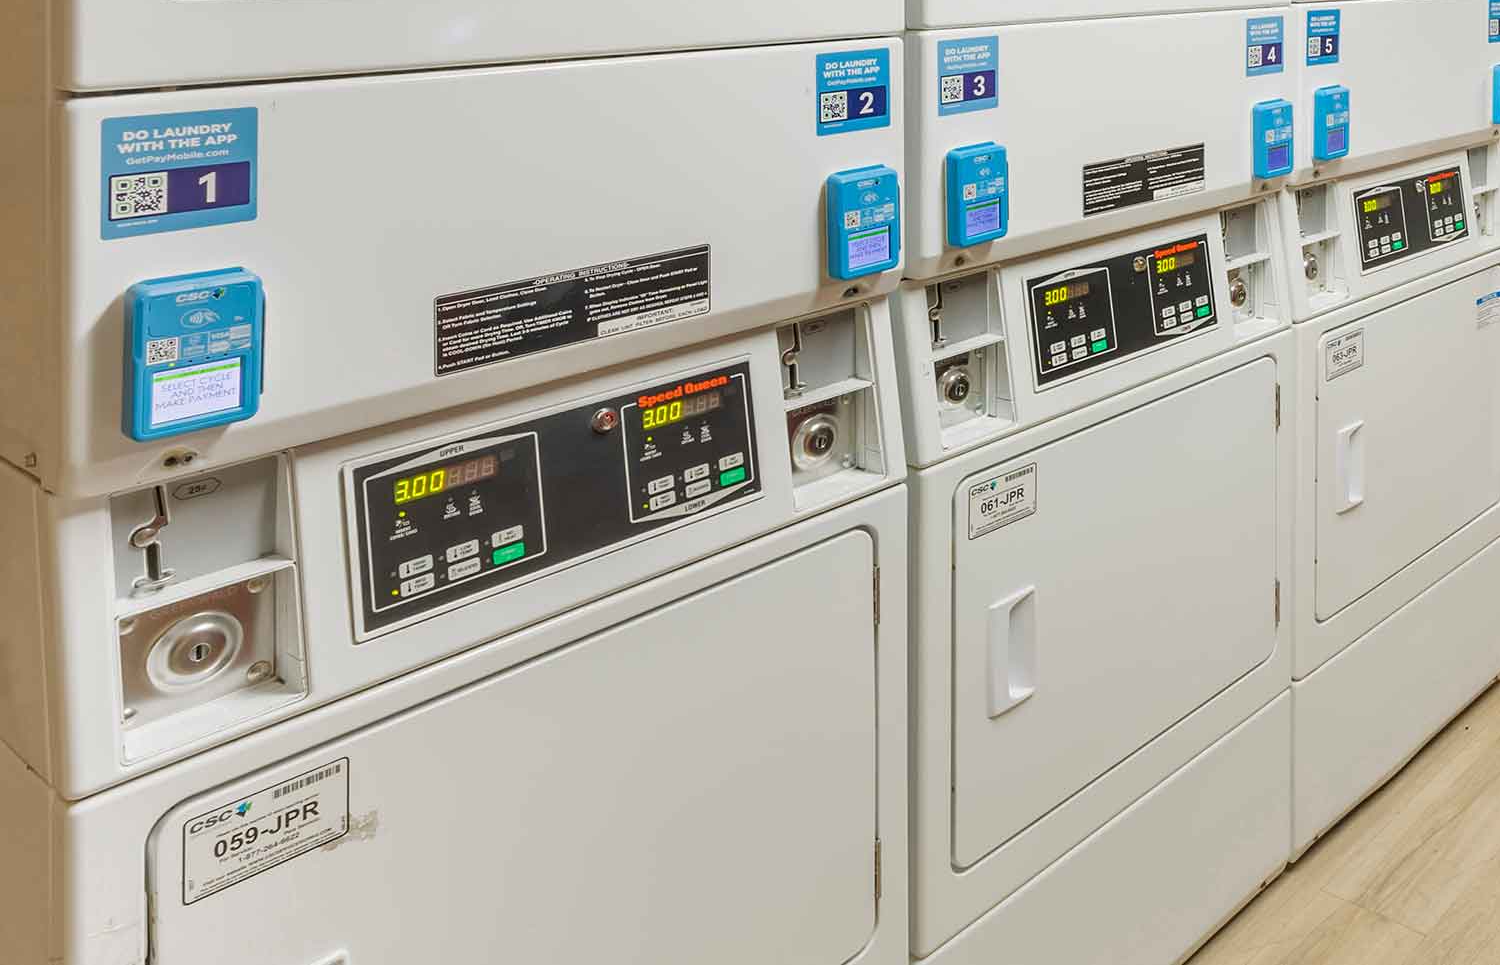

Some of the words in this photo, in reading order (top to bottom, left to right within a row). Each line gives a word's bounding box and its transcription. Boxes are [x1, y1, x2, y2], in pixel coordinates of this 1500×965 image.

[1267, 46, 1276, 63] 4
[1325, 38, 1333, 54] 5
[823, 69, 845, 79] WITH
[847, 68, 863, 76] THE
[864, 66, 880, 74] APP
[825, 62, 838, 70] DO
[840, 58, 878, 69] LAUNDRY
[973, 76, 985, 96] 3
[859, 92, 874, 115] 2
[122, 131, 149, 141] DO
[152, 122, 233, 138] LAUNDRY
[117, 141, 164, 155] WITH
[168, 137, 201, 149] THE
[205, 134, 238, 146] APP
[125, 148, 230, 166] GetPayMobile.com
[198, 171, 217, 204] 1
[175, 289, 210, 303] CSC
[637, 385, 683, 409] Speed
[683, 375, 728, 395] Queen
[643, 401, 681, 429] 3.00
[439, 444, 465, 458] UPPER
[395, 470, 446, 505] 3.00
[971, 484, 990, 497] CSC
[980, 487, 1025, 514] 061-JPR
[189, 809, 233, 835] CSC
[213, 800, 320, 859] 059-JPR
